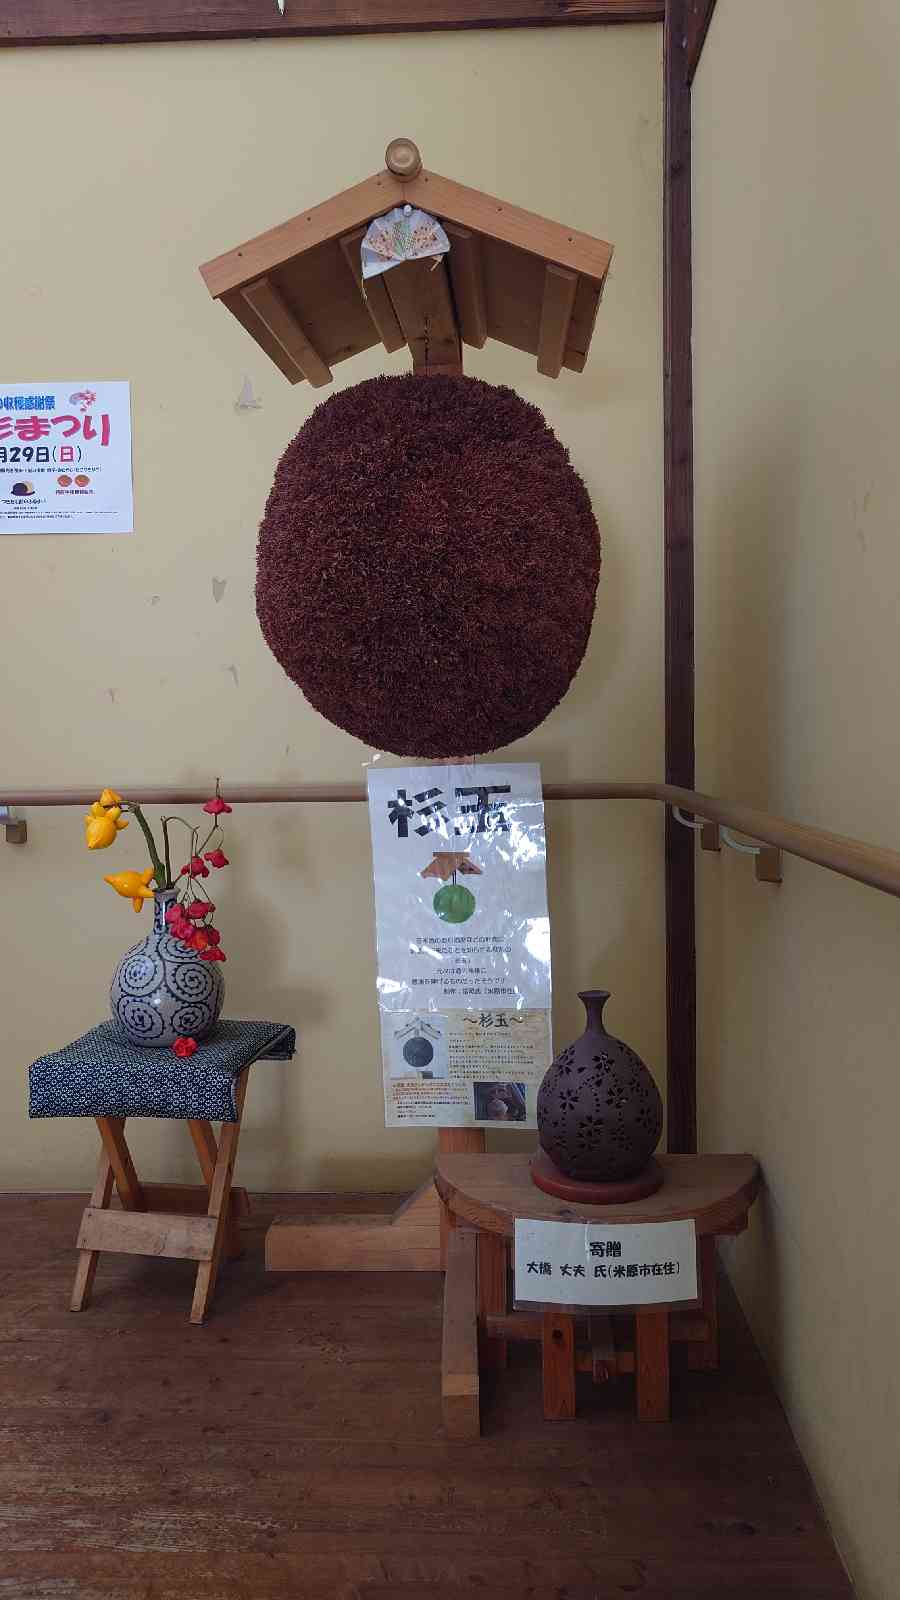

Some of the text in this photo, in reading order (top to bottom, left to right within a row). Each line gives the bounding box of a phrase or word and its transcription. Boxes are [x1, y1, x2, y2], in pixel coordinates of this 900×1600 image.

[0, 396, 56, 410] 収穫感謝祭
[387, 785, 511, 837] 杉玉
[589, 1240, 622, 1258] 寄贈
[526, 1261, 552, 1275] 大橋
